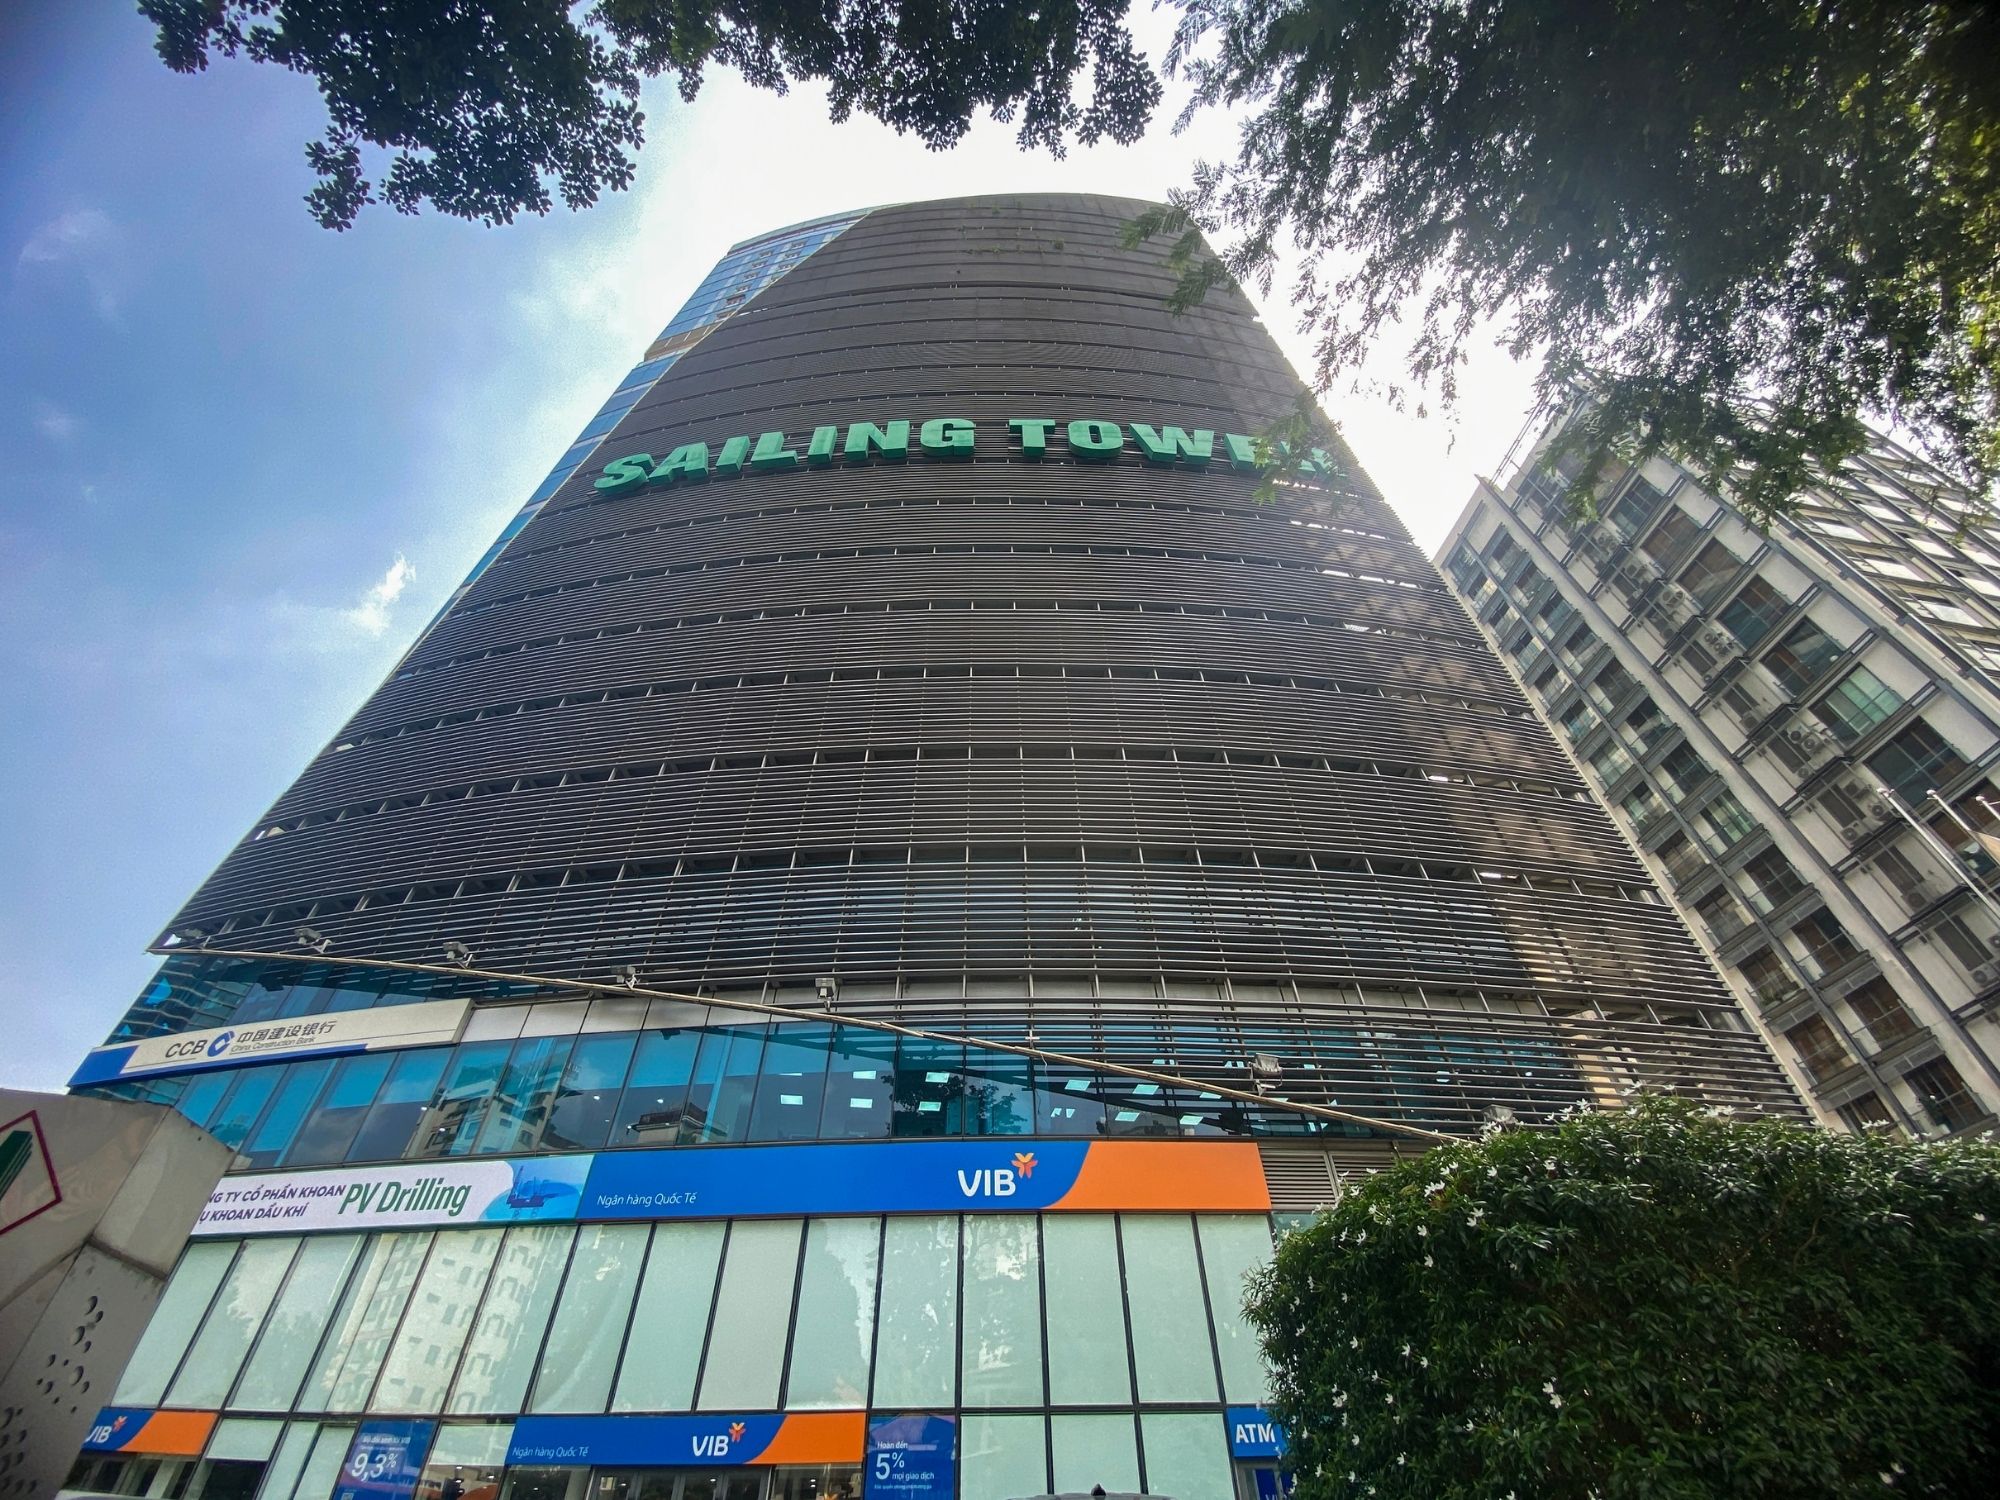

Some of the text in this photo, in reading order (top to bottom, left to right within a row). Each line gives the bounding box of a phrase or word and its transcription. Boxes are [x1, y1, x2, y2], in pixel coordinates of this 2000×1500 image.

[594, 418, 976, 493] SAILING
[237, 1020, 338, 1043] 中国建设银行
[165, 1039, 208, 1059] CCB
[231, 1036, 315, 1053] China Construction Bank
[224, 1191, 243, 1203] TY
[298, 1184, 347, 1199] KHOAN
[957, 1169, 1017, 1197] VIB
[338, 1177, 473, 1217] PV Drilling
[597, 1191, 698, 1209] Ngân hàng Quốc Tế
[209, 1207, 256, 1222] KHOAN
[282, 1202, 309, 1218] KHÍ
[1235, 1422, 1276, 1444] ATM
[512, 1445, 590, 1460] Ngân hàng Quốc Tế
[692, 1435, 729, 1457] VIB
[351, 1452, 399, 1482] 9,3%
[875, 1452, 905, 1480] 5%
[905, 1472, 920, 1482] giao
